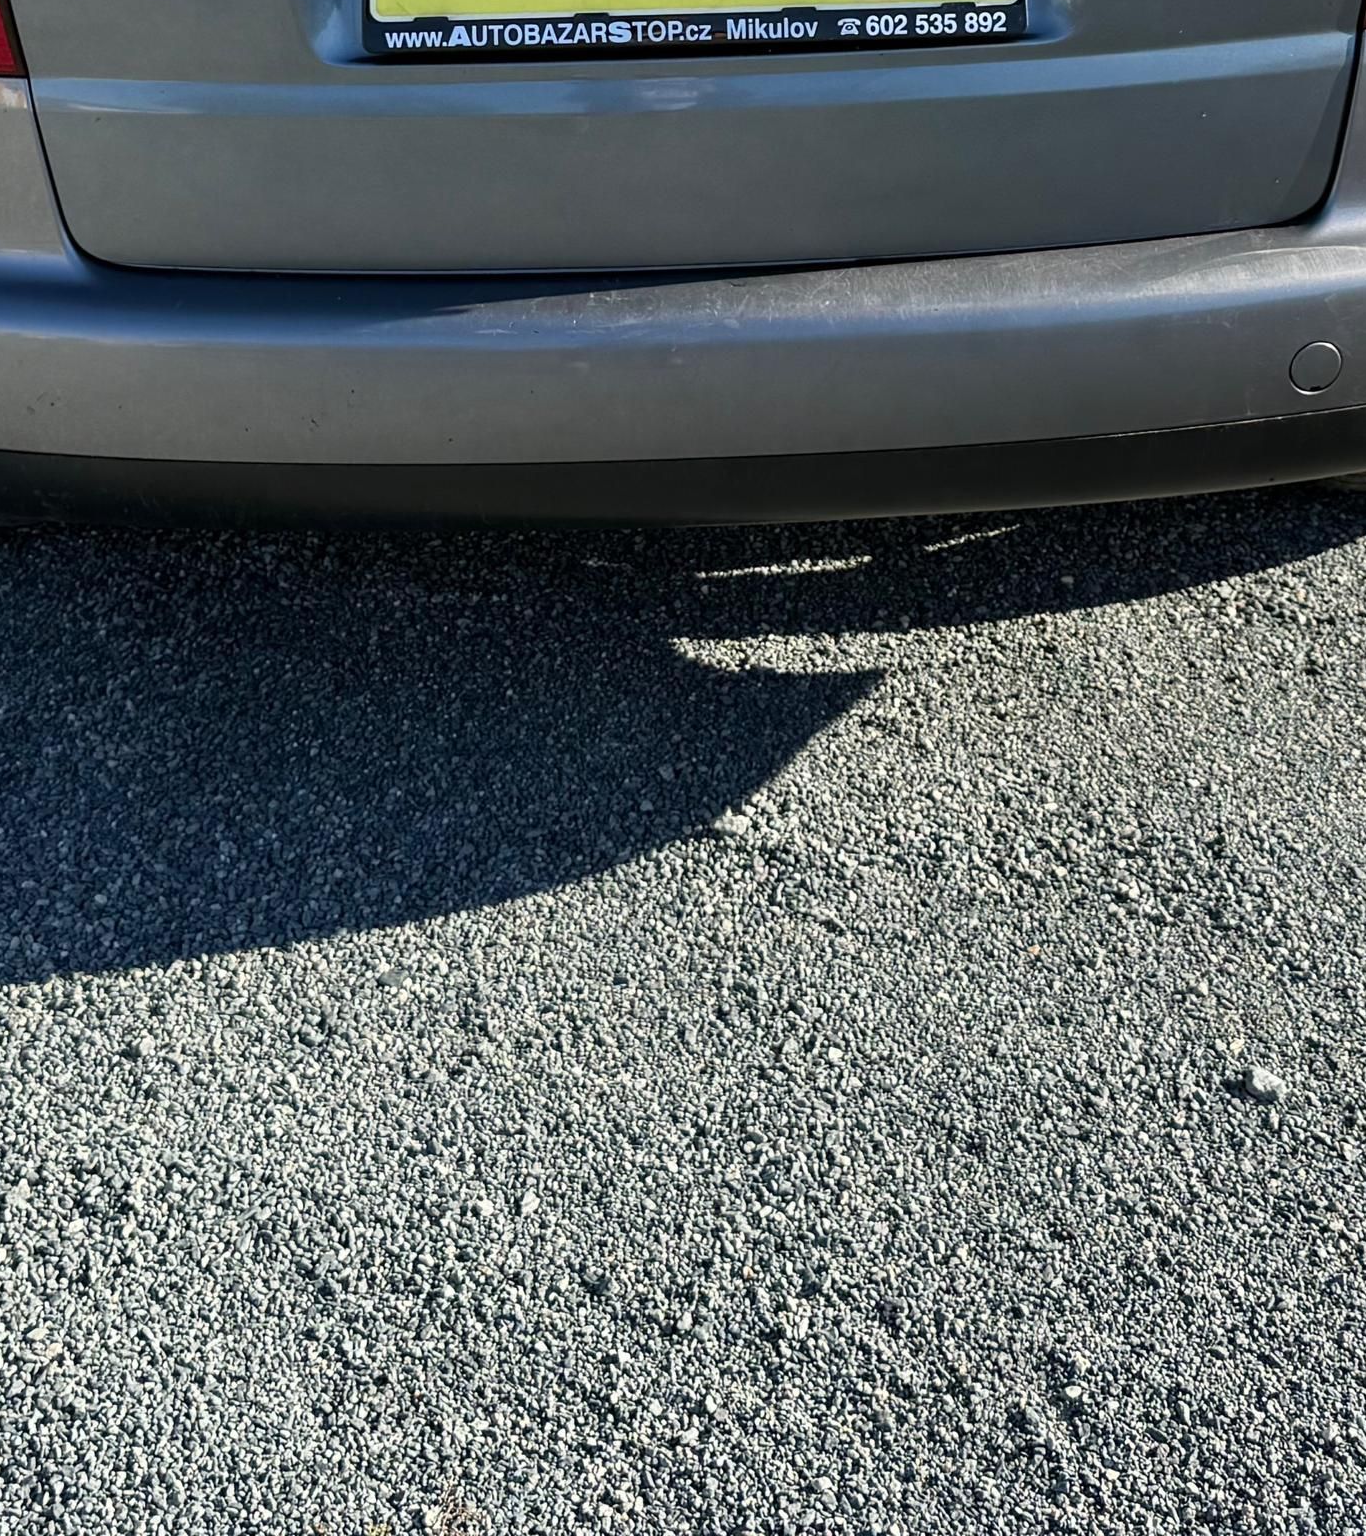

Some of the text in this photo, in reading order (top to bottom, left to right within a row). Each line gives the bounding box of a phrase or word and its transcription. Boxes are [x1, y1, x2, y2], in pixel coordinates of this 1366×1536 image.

[384, 11, 1007, 50] www.AUTOBAZARSTOP.cz Mikulov 602 535 892
